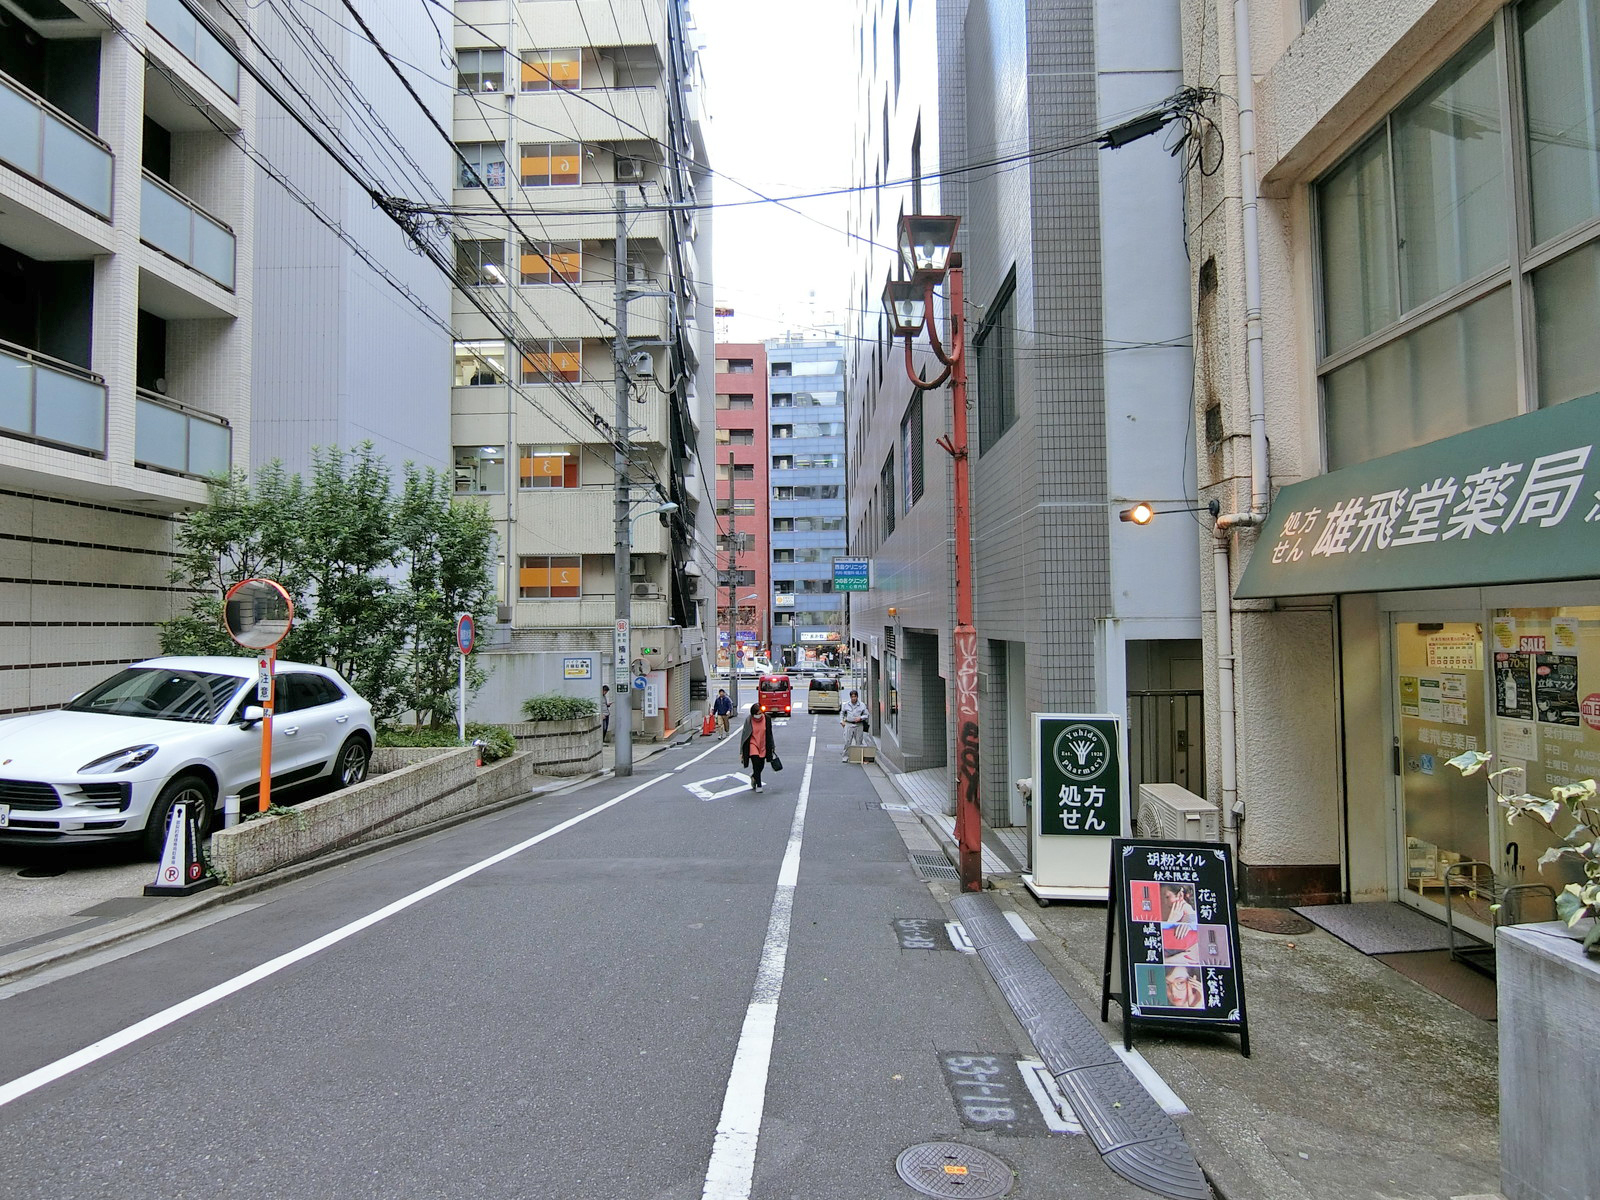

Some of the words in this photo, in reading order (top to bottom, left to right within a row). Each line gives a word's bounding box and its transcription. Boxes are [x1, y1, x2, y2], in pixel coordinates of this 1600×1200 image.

[1311, 445, 1593, 558] 雄飛堂薬局
[1280, 507, 1322, 537] 処方
[1271, 538, 1304, 564] せん
[1521, 638, 1545, 652] SALE
[260, 673, 269, 698] 注意
[1538, 679, 1576, 690] 立体マスク
[1066, 729, 1098, 742] Yuhido
[1418, 728, 1478, 751] 雄飛堂薬局
[1062, 758, 1103, 775] Pharmacy
[1059, 784, 1106, 807] 処方
[1059, 809, 1106, 831] せん
[1146, 851, 1206, 867] 胡粉ネイル
[1153, 871, 1200, 882] 秋冬限定色
[1198, 889, 1212, 920] 花菊
